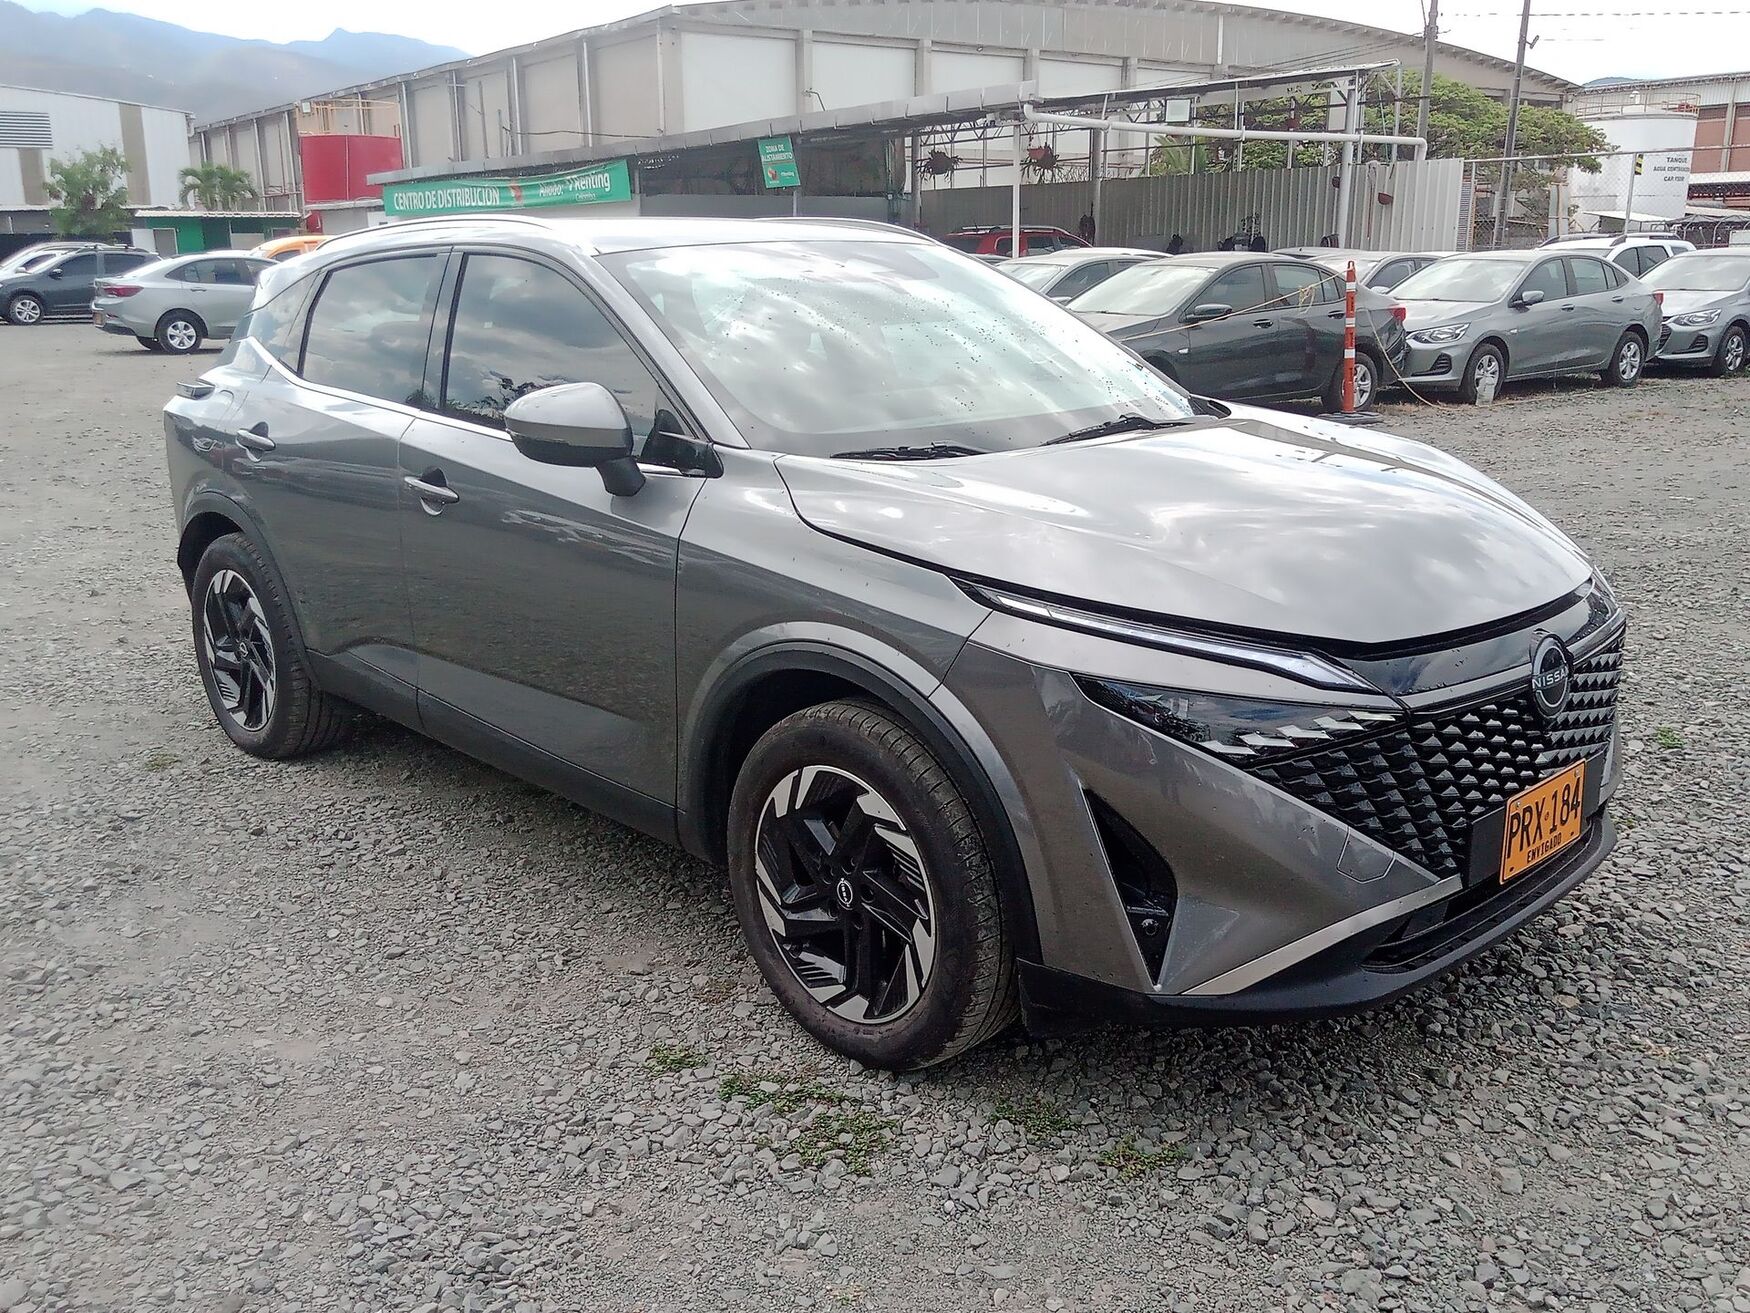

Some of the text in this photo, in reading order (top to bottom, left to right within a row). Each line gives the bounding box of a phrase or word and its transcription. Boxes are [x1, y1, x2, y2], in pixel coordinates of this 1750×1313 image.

[393, 192, 424, 210] CENTRO
[425, 190, 439, 209] DE
[1526, 832, 1562, 863] ENVIGADO
